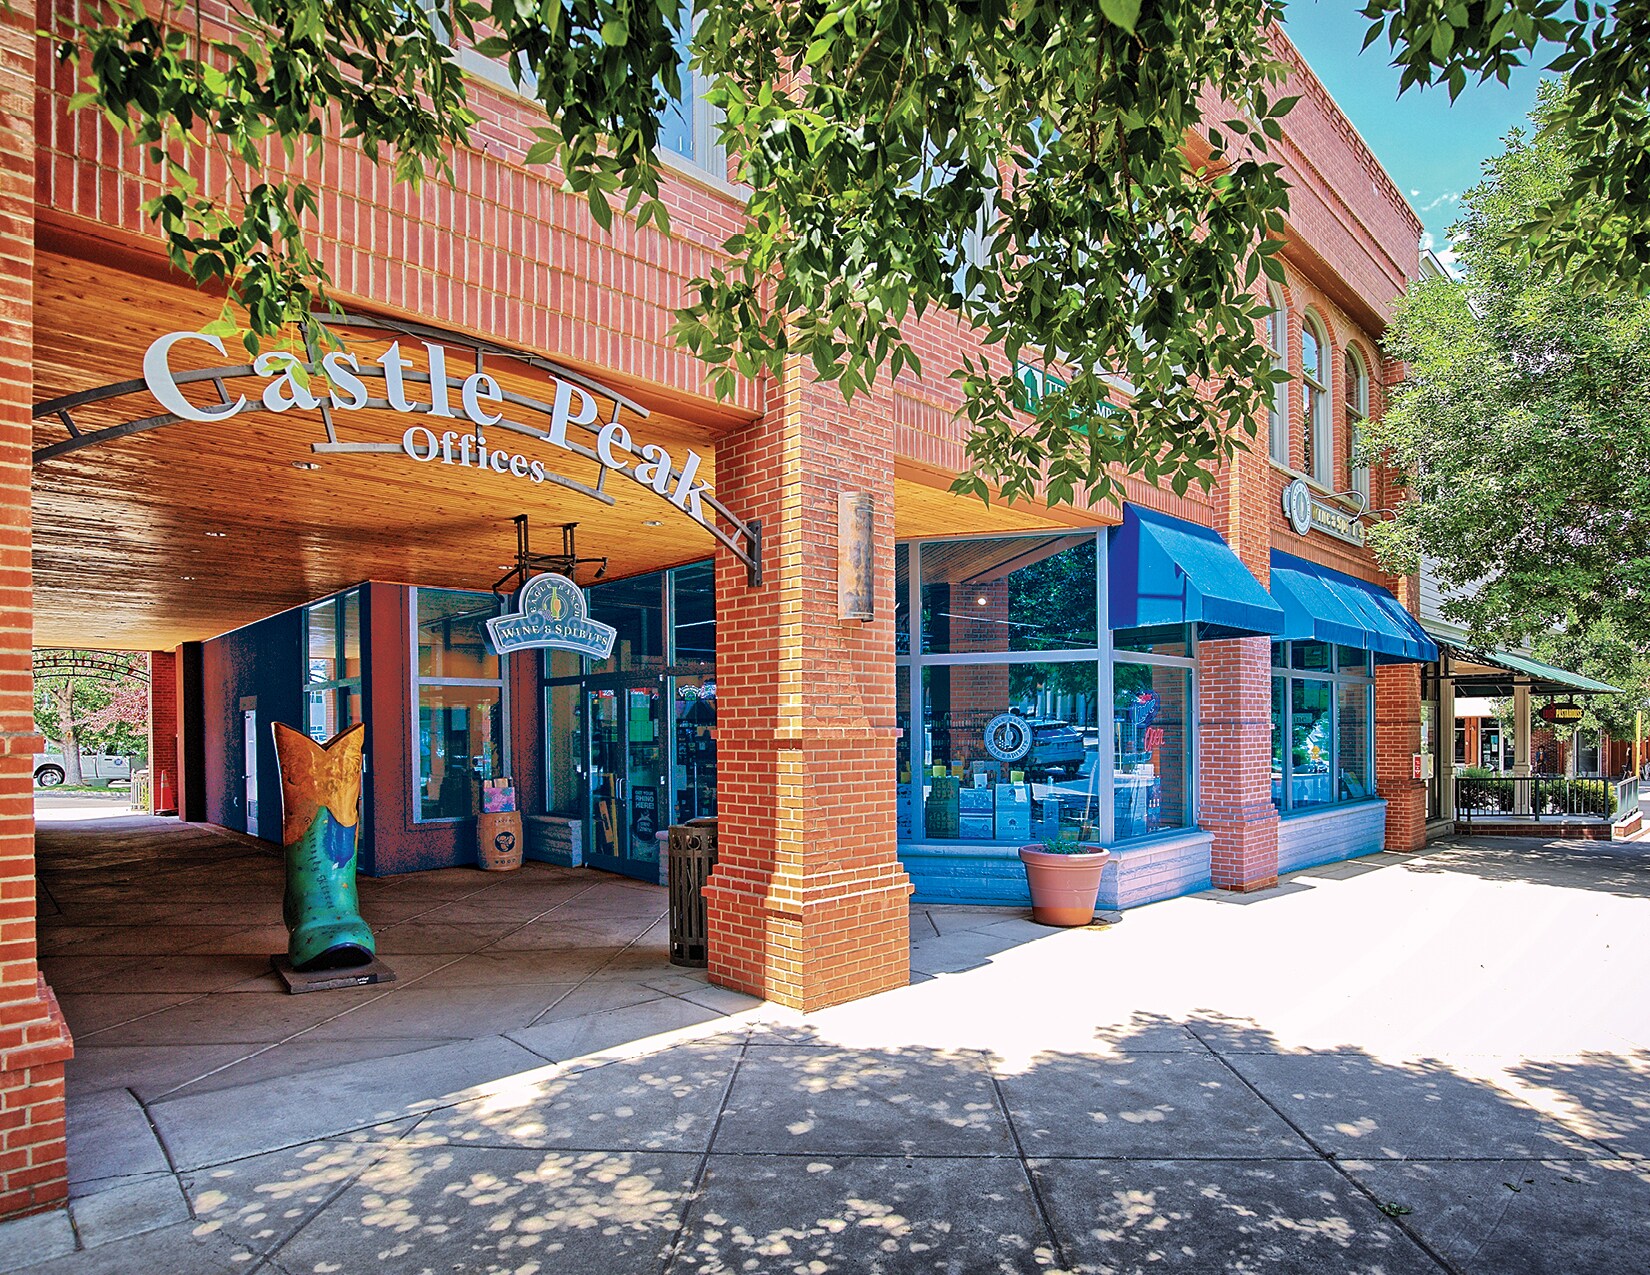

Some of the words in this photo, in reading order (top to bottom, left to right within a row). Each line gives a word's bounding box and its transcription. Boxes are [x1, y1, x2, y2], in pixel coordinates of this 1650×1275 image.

[143, 331, 504, 426] Castle
[541, 375, 717, 524] Peak
[402, 427, 546, 484] Offices
[529, 583, 552, 613] EAGLE
[558, 584, 580, 617] RANCH
[502, 625, 540, 639] WINE
[544, 625, 551, 634] &
[555, 625, 608, 646] SPIRITS
[1144, 727, 1165, 752] Open
